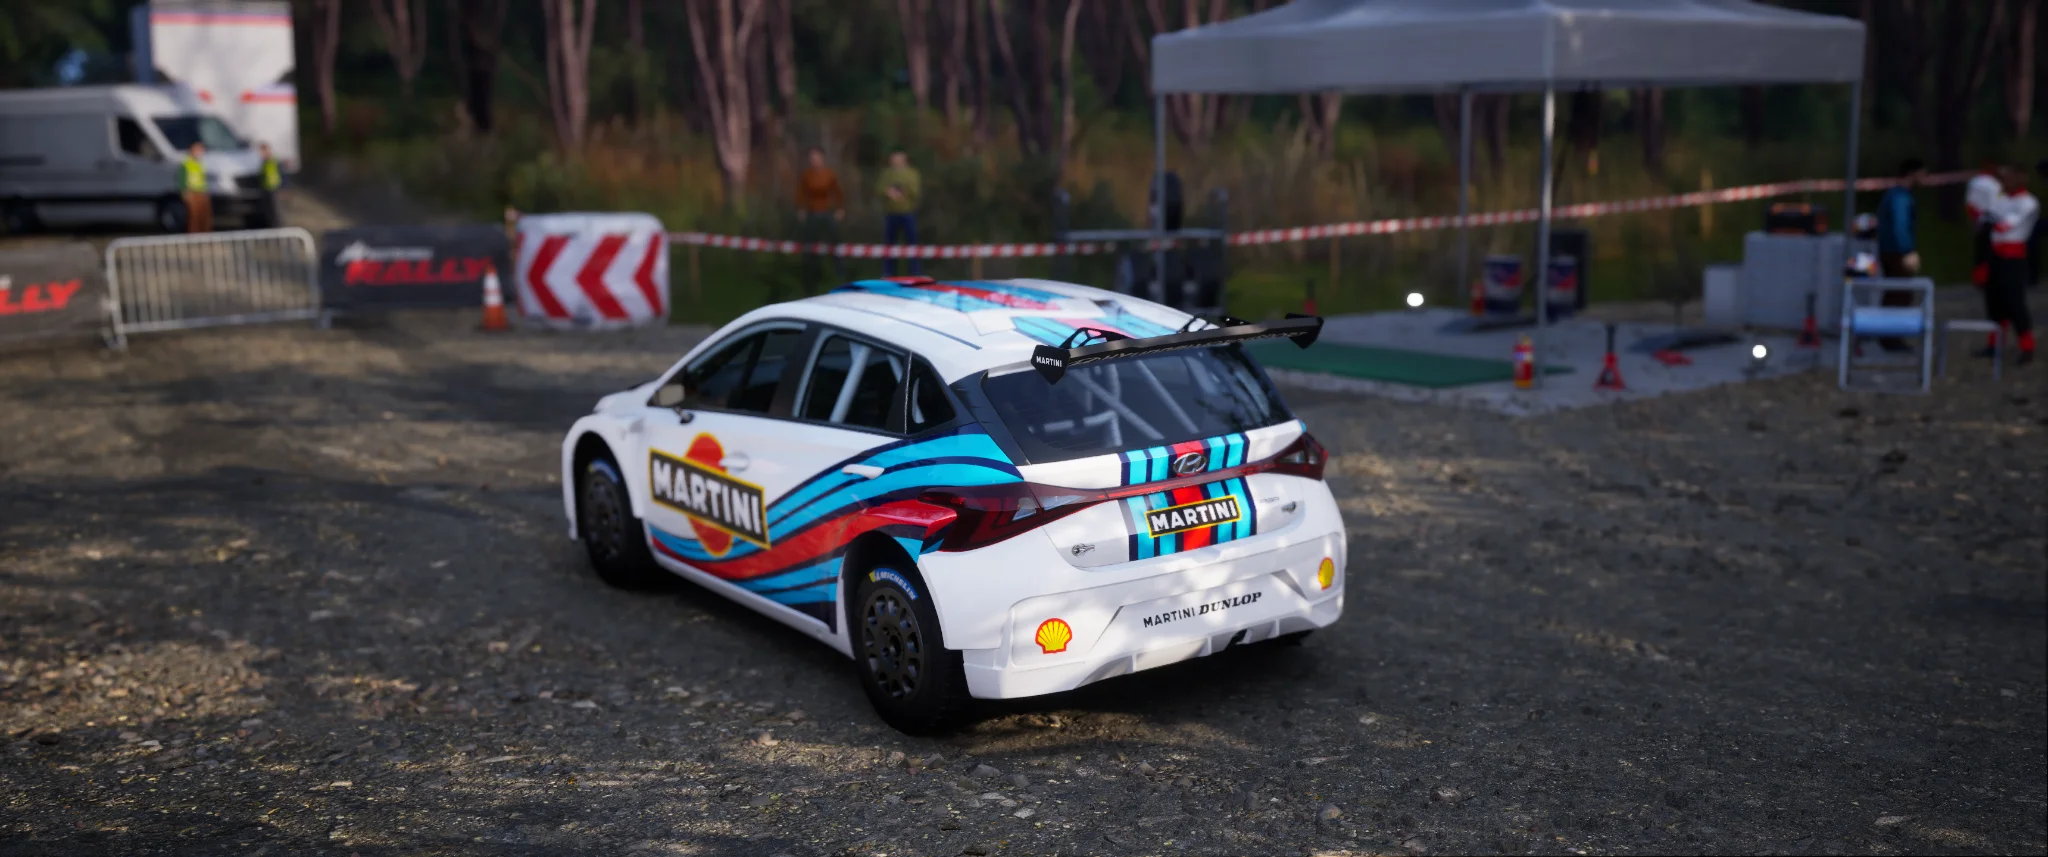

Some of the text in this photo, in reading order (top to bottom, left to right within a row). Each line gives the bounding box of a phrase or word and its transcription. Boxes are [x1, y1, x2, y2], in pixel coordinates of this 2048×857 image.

[344, 256, 493, 286] RALLY
[1036, 355, 1063, 367] MARTINI
[652, 458, 762, 536] MARTINI
[1150, 499, 1238, 532] MARTINI
[880, 571, 917, 600] MICHELIN
[1143, 591, 1262, 628] MARTINI DUNLOP
